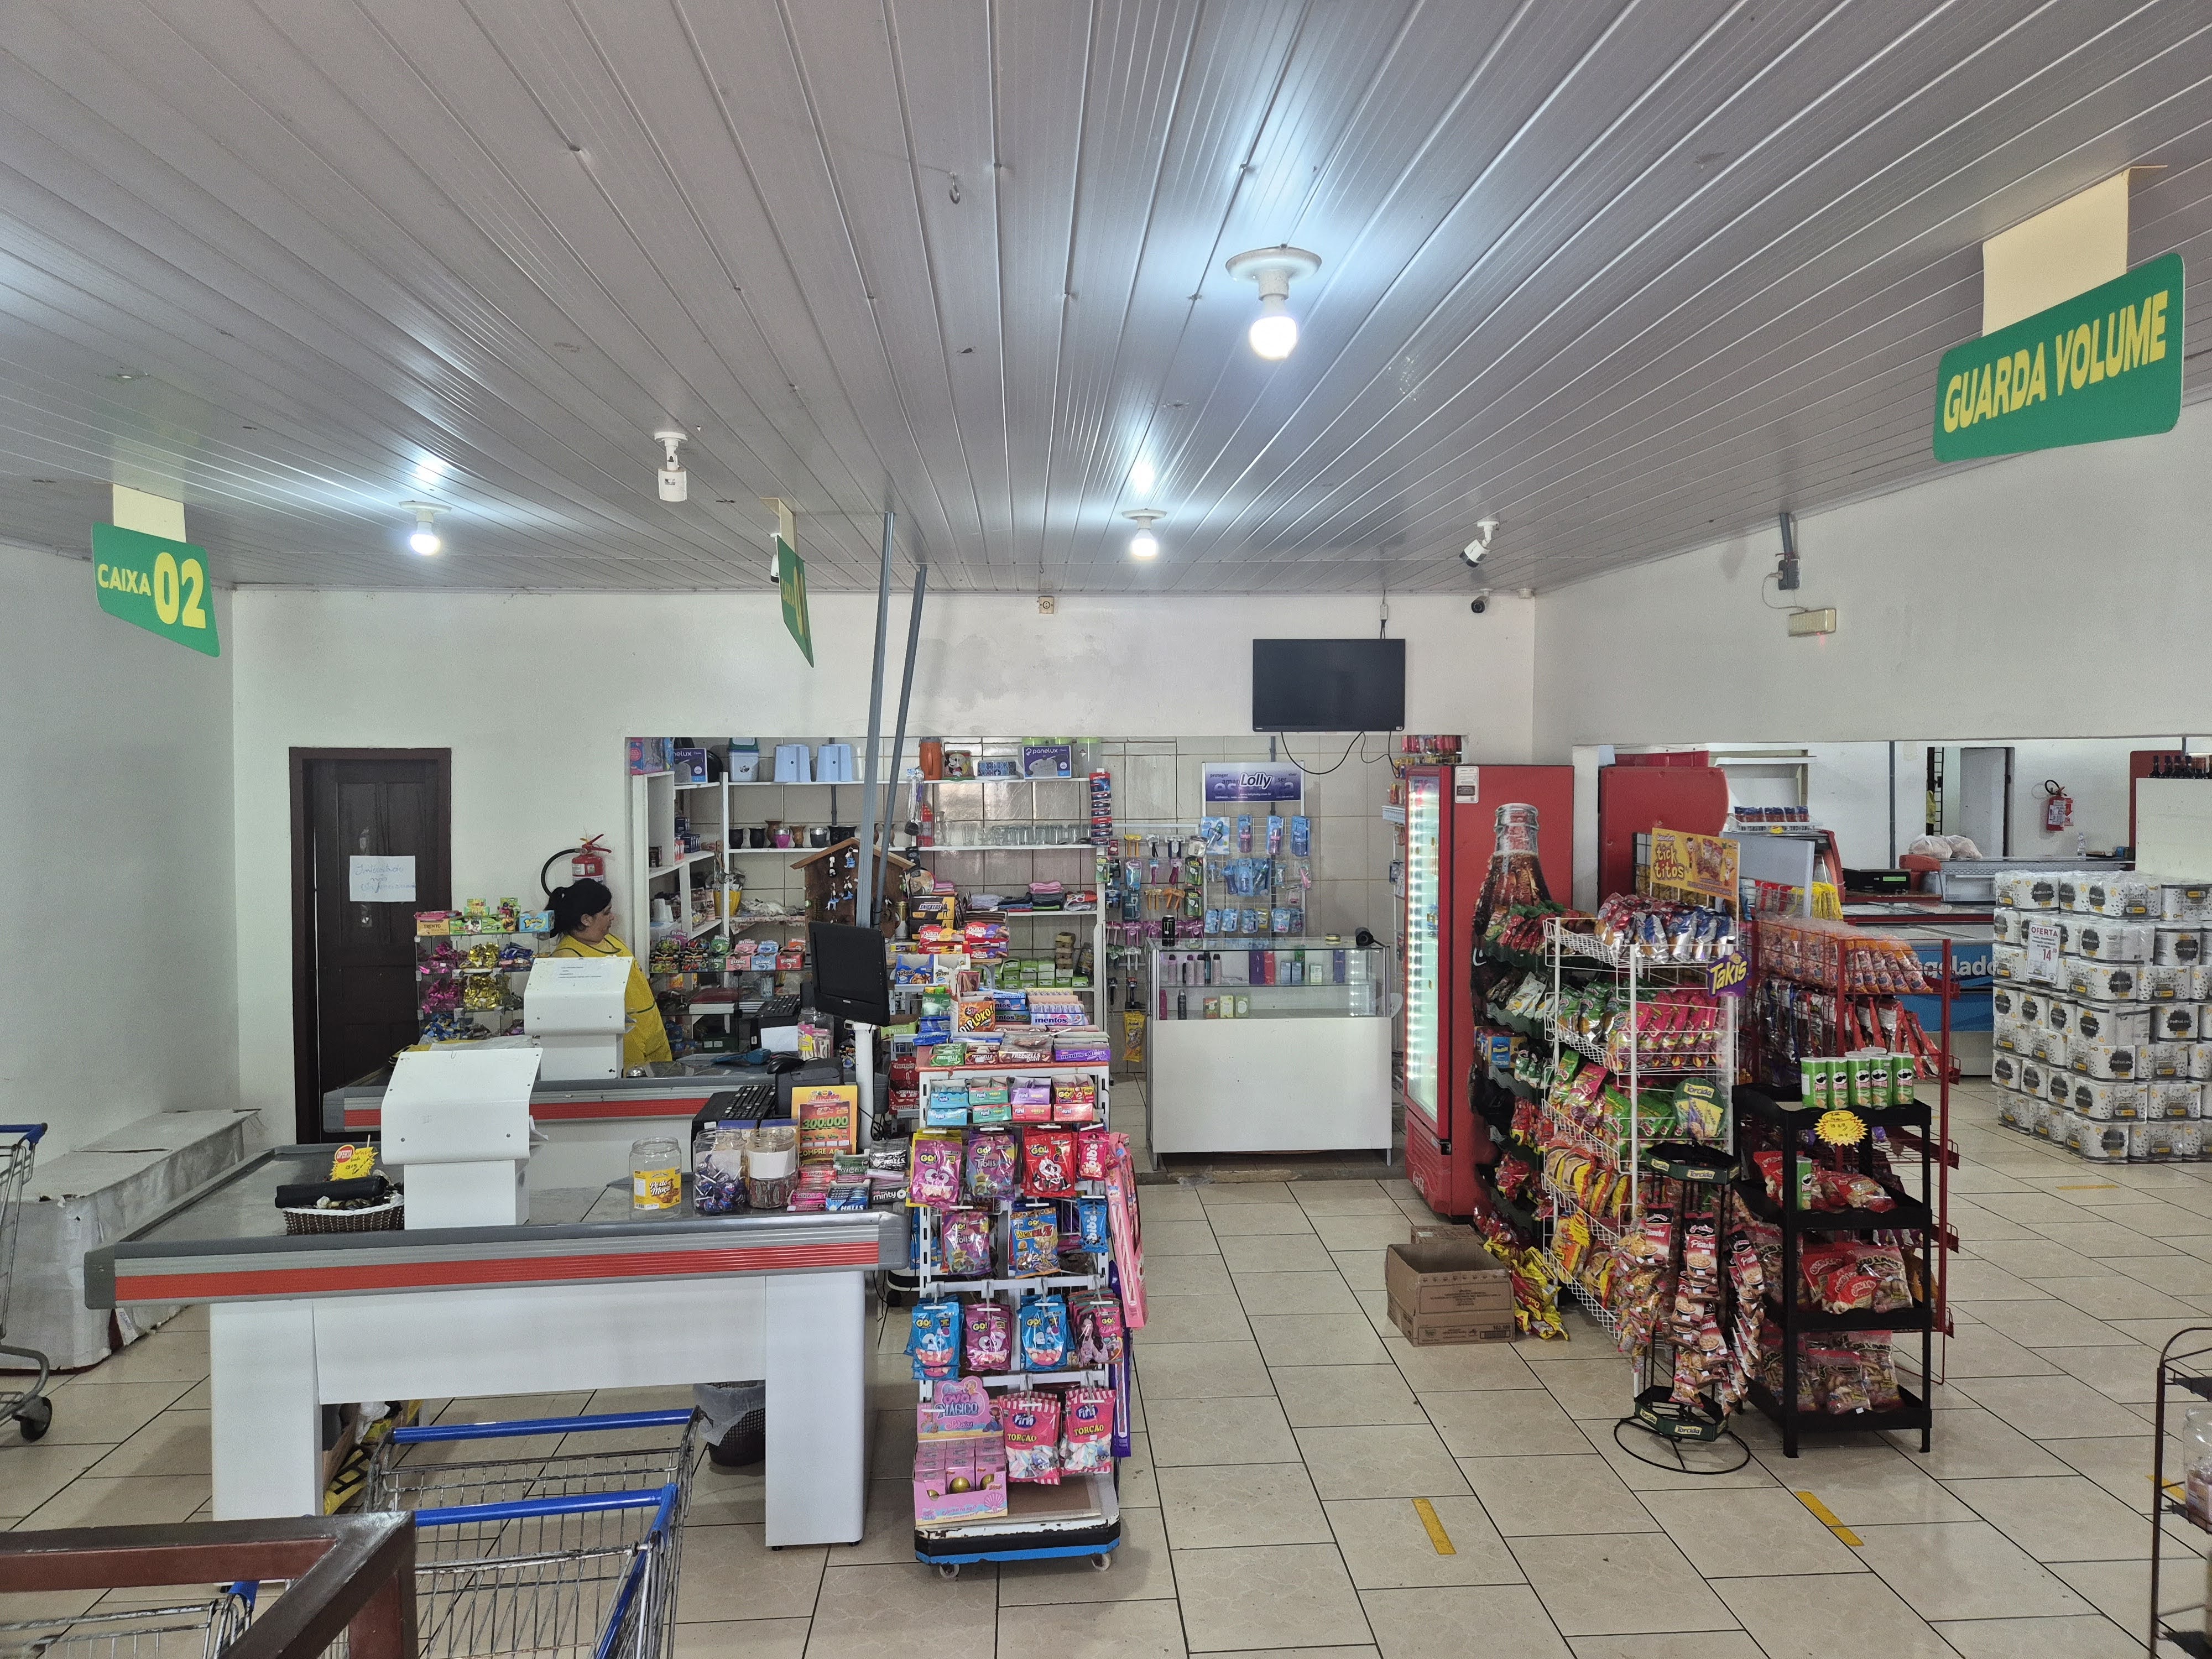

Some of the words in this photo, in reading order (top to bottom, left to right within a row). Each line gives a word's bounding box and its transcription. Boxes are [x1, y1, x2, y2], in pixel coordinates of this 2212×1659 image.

[1943, 342, 2046, 432] GUARDA
[2056, 290, 2168, 396] VOLUME
[98, 564, 152, 596] CAIXA
[154, 552, 206, 628] 02
[1240, 773, 1272, 789] Lolly
[1656, 844, 1677, 864] tick
[1654, 862, 1684, 879] titos
[2031, 927, 2058, 937] OFERTA
[2043, 948, 2051, 961] 14
[1709, 961, 1748, 995] Takis
[1688, 1086, 1712, 1096] Torcida
[802, 1117, 848, 1129] 300.000
[799, 1148, 827, 1157] COMPRE
[1031, 1146, 1047, 1155] GO!
[1087, 1144, 1098, 1168] bib's
[975, 1159, 996, 1168] Trolls
[651, 1187, 671, 1196] Moça
[873, 1190, 896, 1201] minty
[916, 1318, 931, 1327] GO!
[972, 1322, 988, 1330] GO!
[943, 1393, 970, 1404] OVO
[936, 1403, 979, 1418] MÁGICO
[1078, 1405, 1097, 1418] Fini
[945, 1420, 973, 1430] Sereias
[1015, 1415, 1034, 1426] Fini
